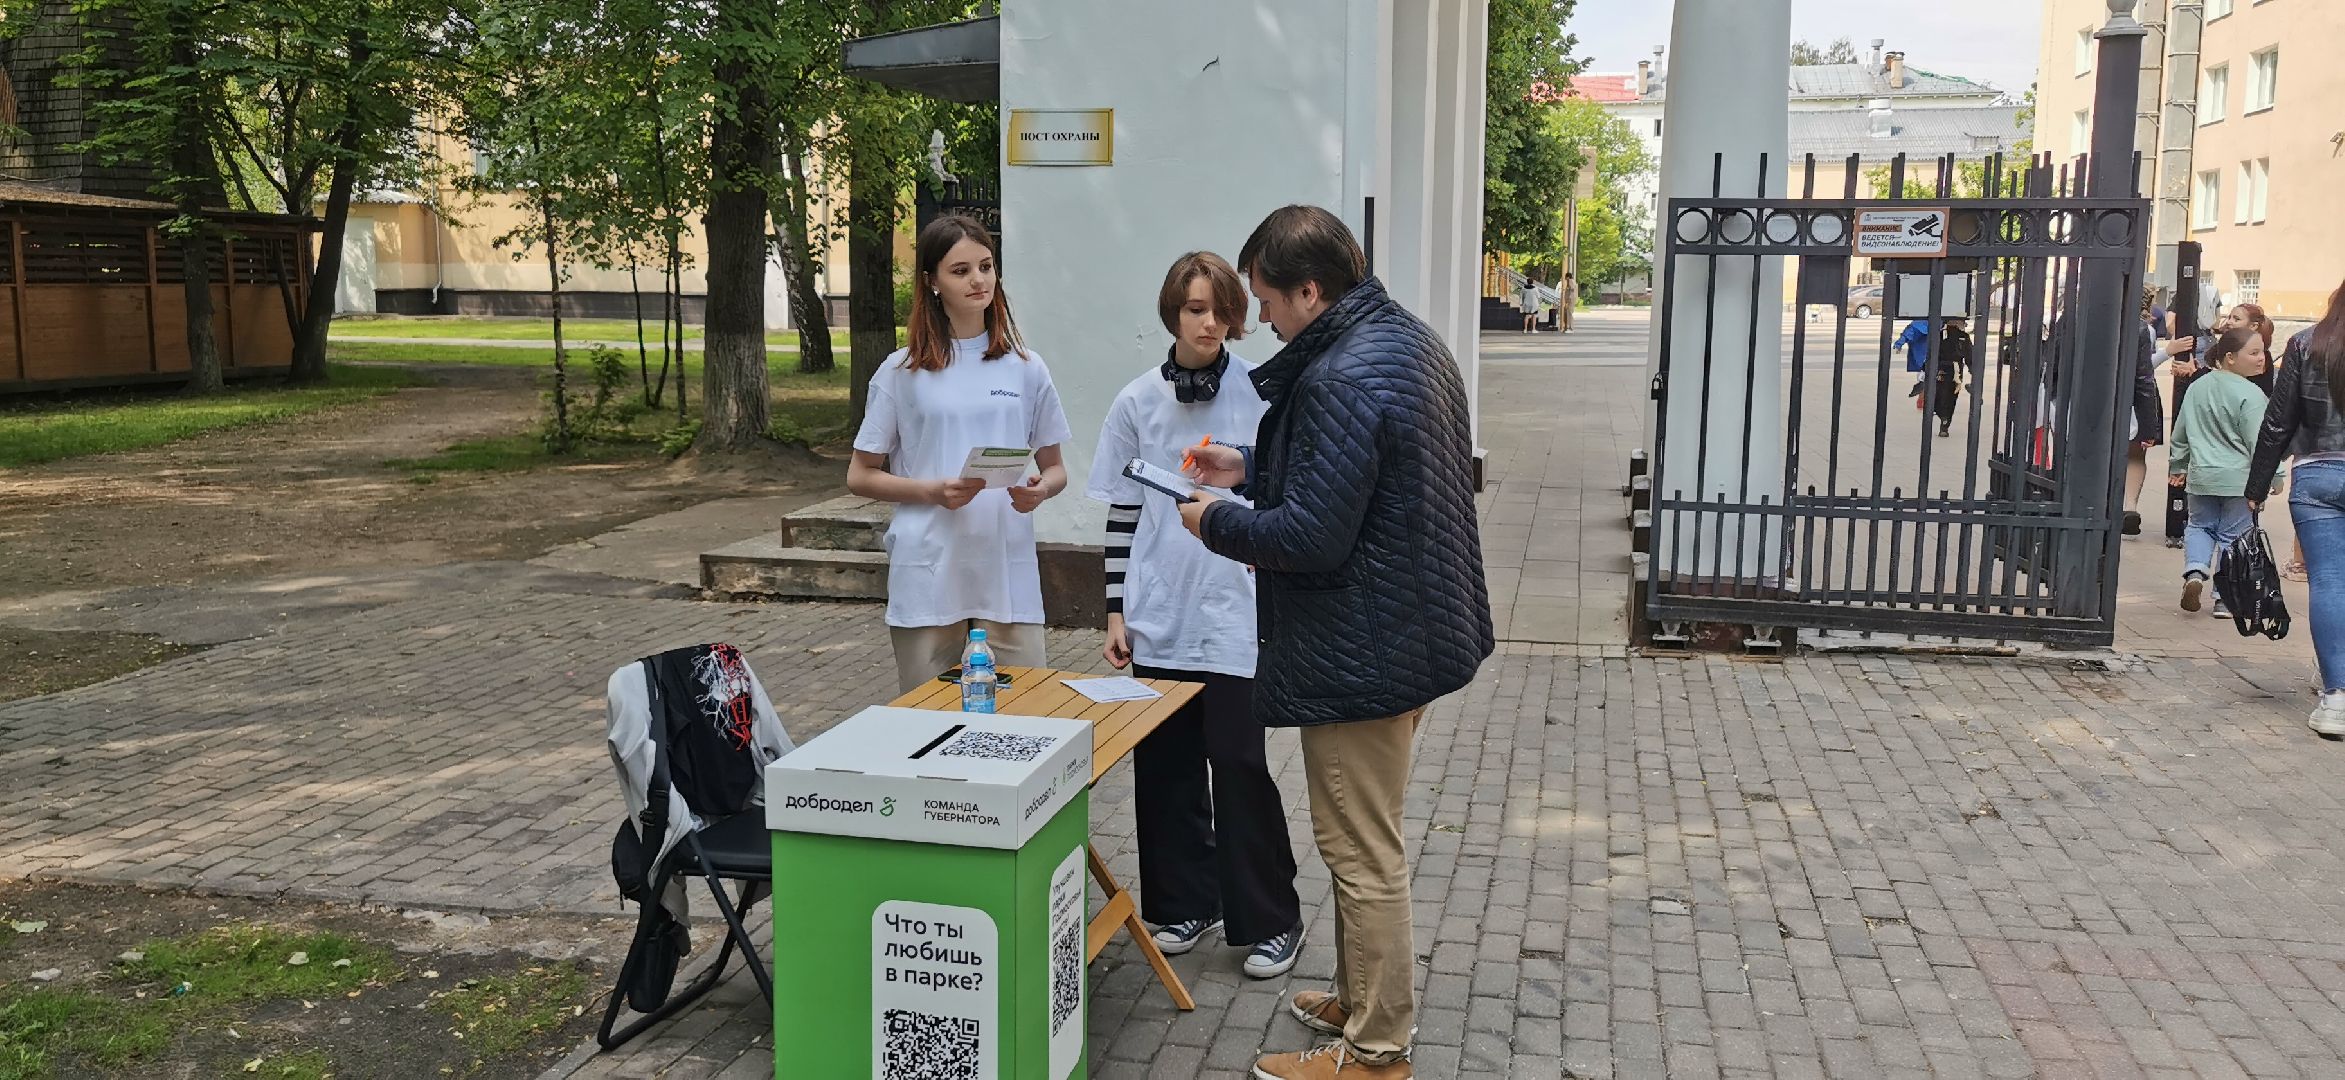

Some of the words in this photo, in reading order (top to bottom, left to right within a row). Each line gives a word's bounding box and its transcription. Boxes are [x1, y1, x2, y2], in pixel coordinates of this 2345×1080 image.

[1020, 132, 1049, 141] ПОСТ
[1051, 132, 1100, 141] ОХРАНЫ
[785, 793, 873, 814] добродел
[924, 800, 979, 813] КОМАНДА
[924, 811, 1000, 826] ГУБЕРНАТОРА
[885, 913, 927, 935] Что
[933, 922, 963, 939] ты
[884, 941, 983, 966] любишь
[886, 967, 898, 982] в
[904, 969, 983, 992] парке?
